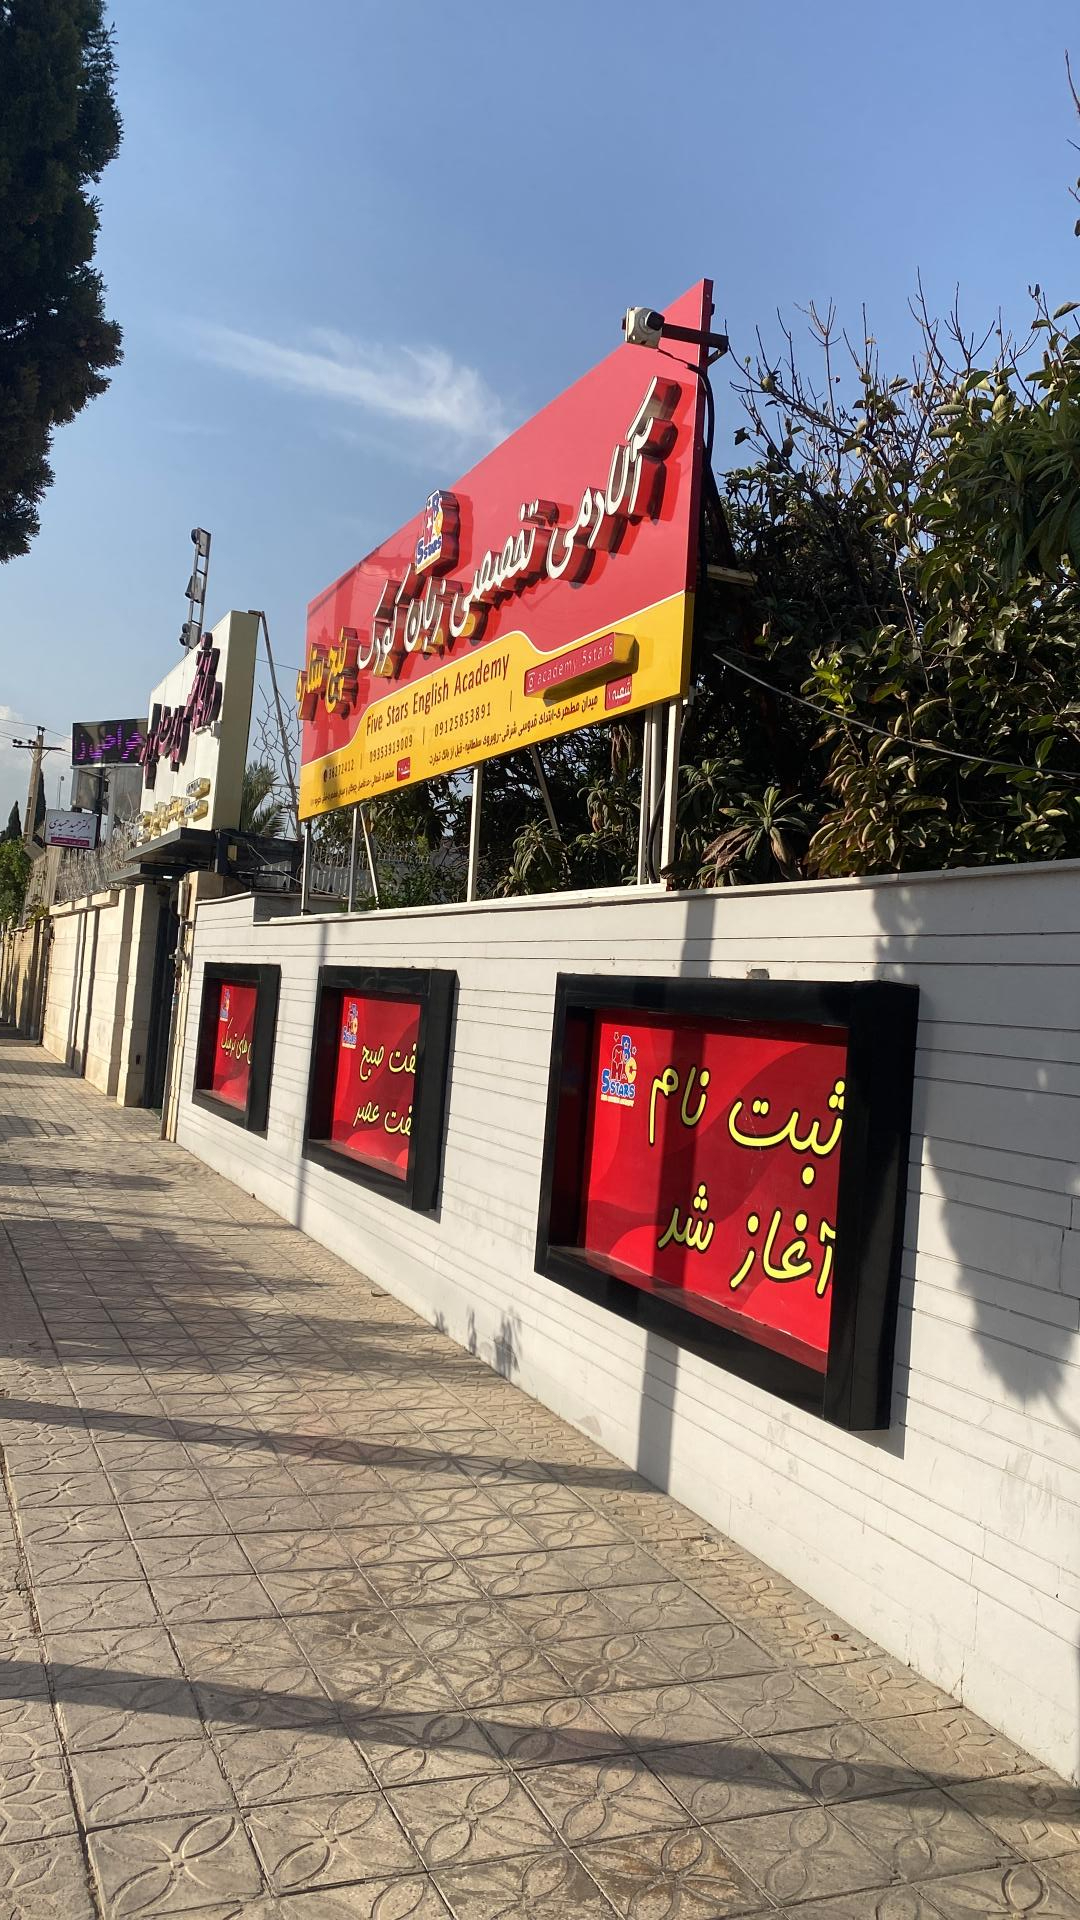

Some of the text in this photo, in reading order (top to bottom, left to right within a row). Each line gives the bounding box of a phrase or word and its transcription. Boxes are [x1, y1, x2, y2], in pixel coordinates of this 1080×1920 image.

[547, 375, 658, 580] آکادمی
[449, 498, 540, 638] تخصصی
[357, 562, 414, 676] کودک
[403, 576, 446, 653] زبان
[366, 653, 510, 737] Five Stars English Academy
[434, 702, 491, 737] 09125853891
[581, 696, 598, 713] میدان
[360, 1045, 384, 1081] صبح
[353, 1101, 380, 1127] عصر
[649, 1066, 844, 1185] ثبت نام
[658, 1184, 836, 1295] آغاز شد
